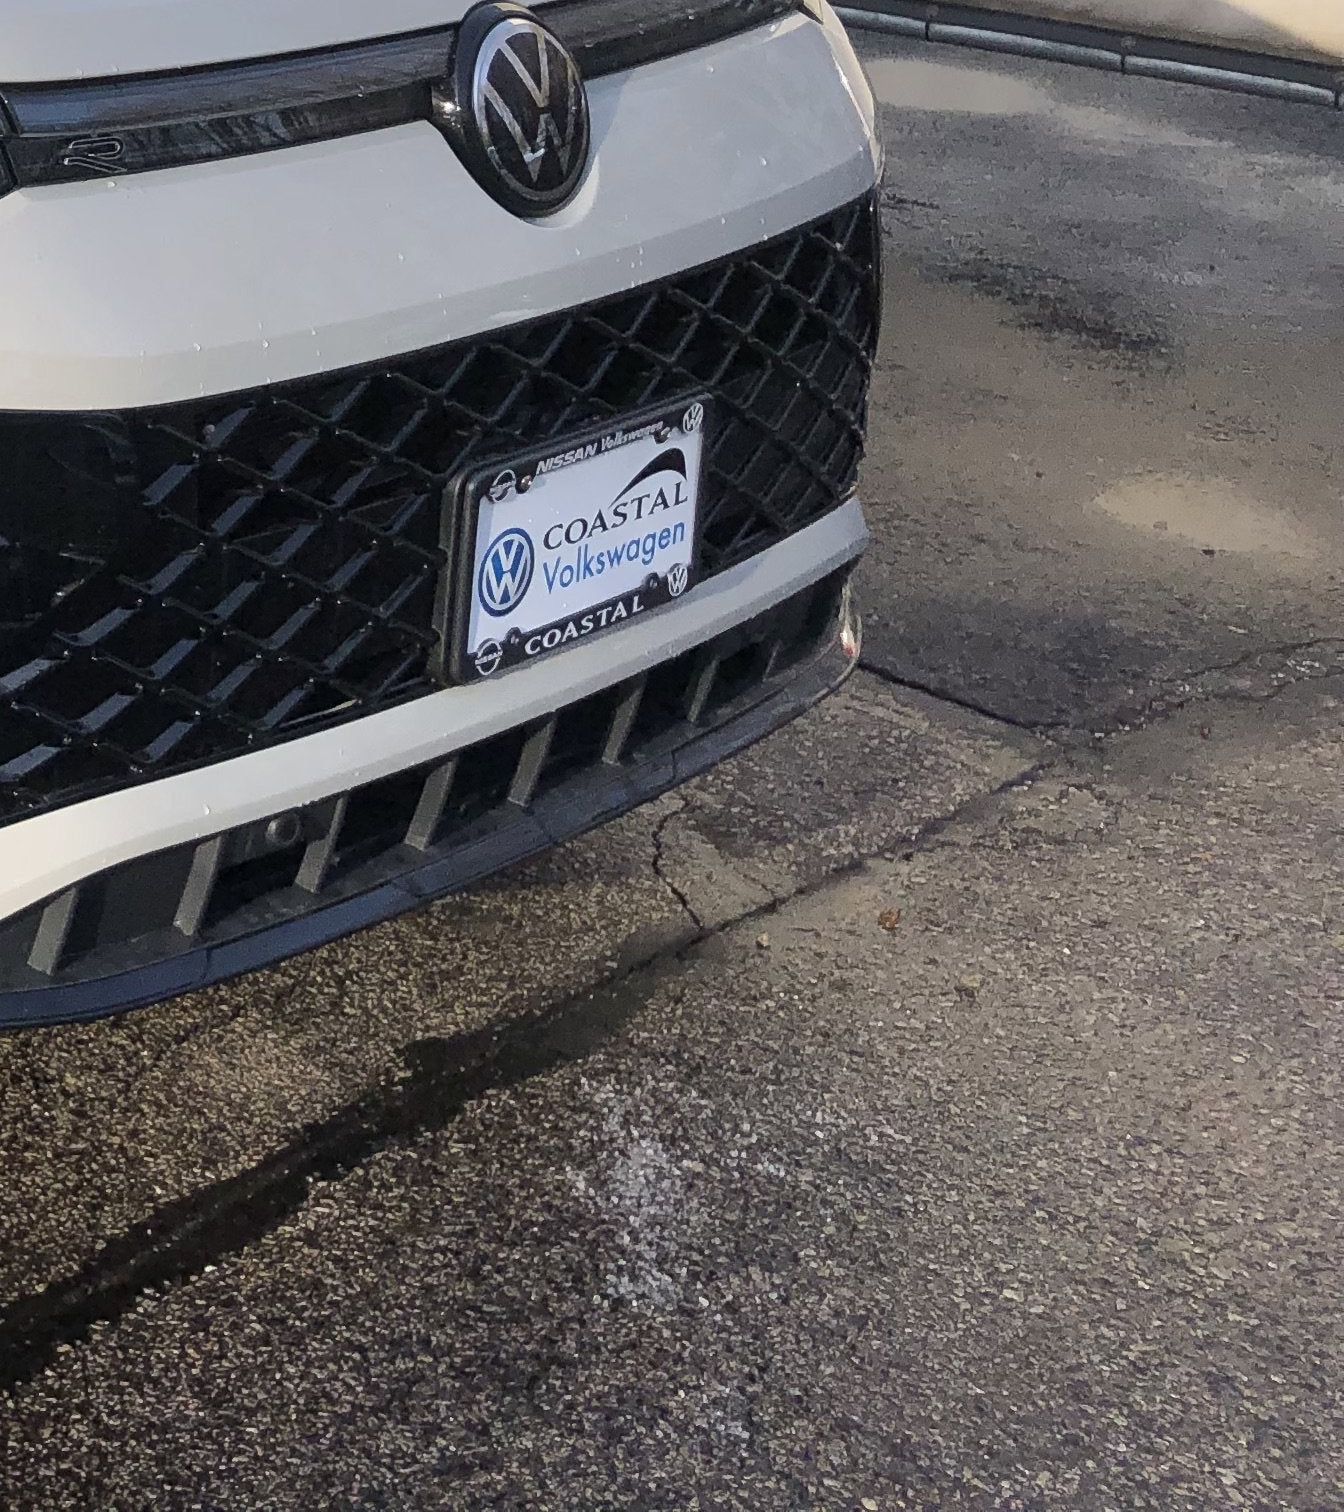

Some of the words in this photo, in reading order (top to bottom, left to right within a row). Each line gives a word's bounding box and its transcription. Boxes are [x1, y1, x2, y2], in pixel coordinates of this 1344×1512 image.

[535, 442, 598, 475] NISSAN
[542, 481, 688, 551] COASTAL
[542, 521, 686, 595] Volkswagen
[524, 594, 645, 655] COASTAL
